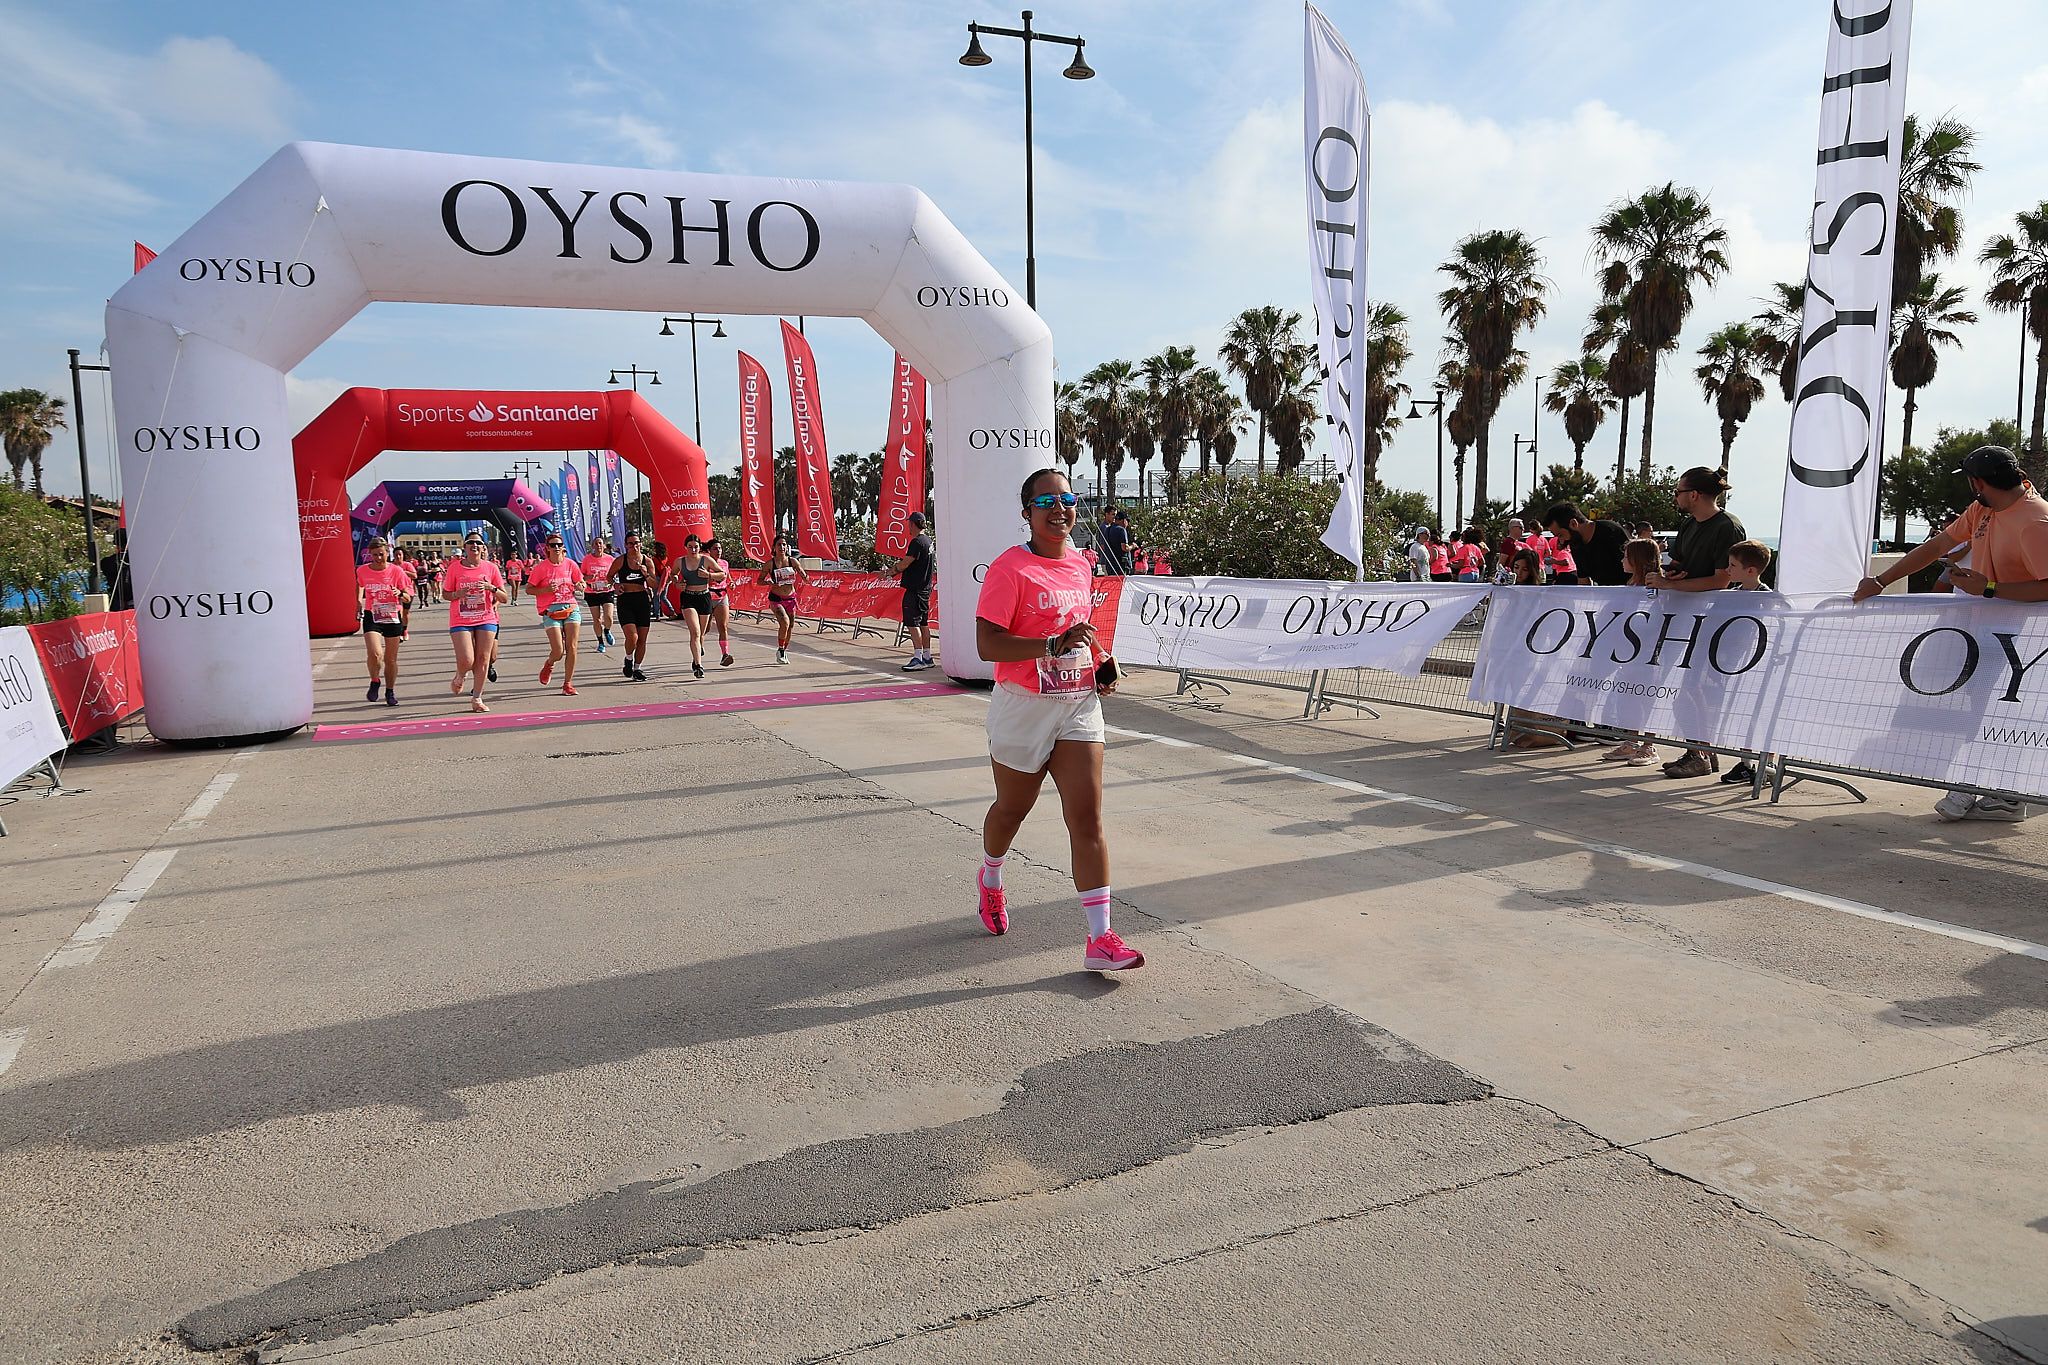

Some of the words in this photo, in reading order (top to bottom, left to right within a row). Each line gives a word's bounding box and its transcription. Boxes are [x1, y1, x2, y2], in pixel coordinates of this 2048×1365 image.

[440, 179, 821, 272] OYSHO
[179, 258, 316, 288] OYSHO
[917, 286, 1009, 307] OYSHO
[398, 404, 464, 426] Sports
[496, 405, 599, 422] Santander
[134, 426, 261, 453] OYSHO
[466, 429, 533, 437] sportssantander.es
[968, 428, 1051, 449] OYSHO
[672, 488, 699, 498] Sports
[298, 513, 343, 522] Santander
[671, 502, 708, 511] Santander
[150, 590, 273, 619] OYSHO
[1139, 592, 1241, 629] OYSHO
[1282, 595, 1431, 636] OYSHO
[1525, 608, 1768, 676] OYSHO
[1566, 675, 1680, 700] WWW.OYSHO.COM
